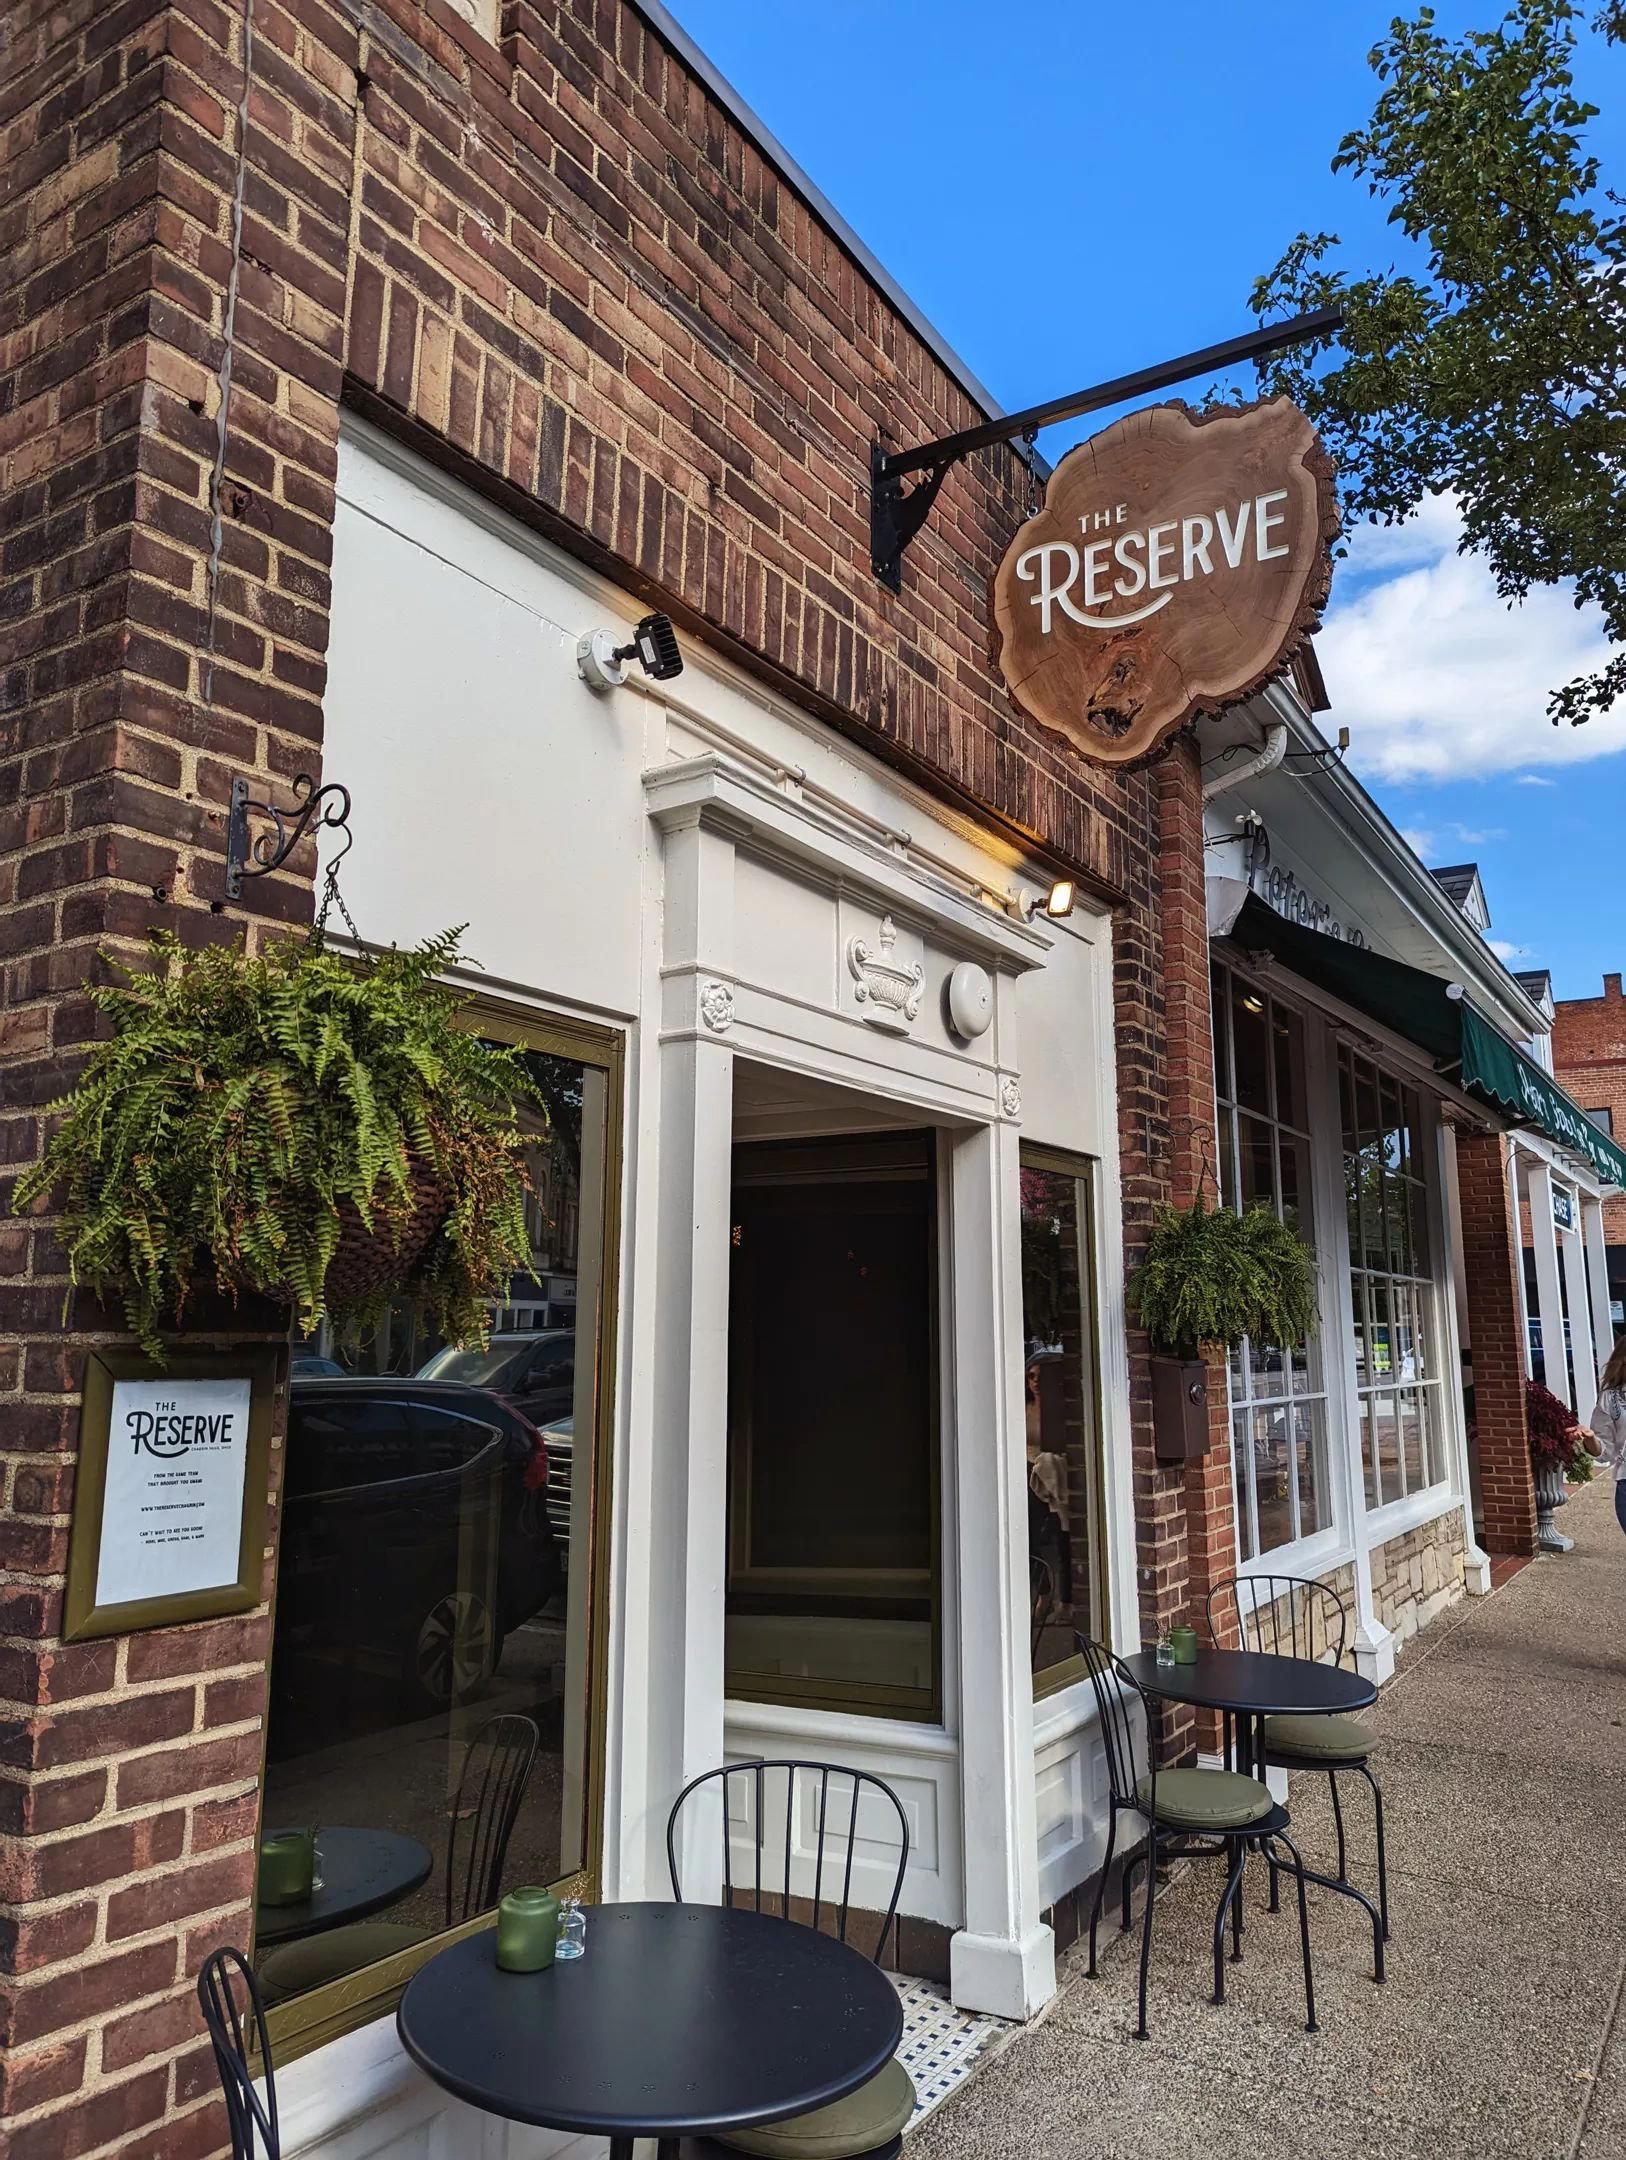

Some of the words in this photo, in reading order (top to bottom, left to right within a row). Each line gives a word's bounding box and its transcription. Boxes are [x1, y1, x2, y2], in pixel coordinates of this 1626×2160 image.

[1077, 502, 1128, 535] THE
[1016, 488, 1290, 634] RESERVE
[155, 1401, 177, 1412] THE
[126, 1411, 234, 1458] RESERVE
